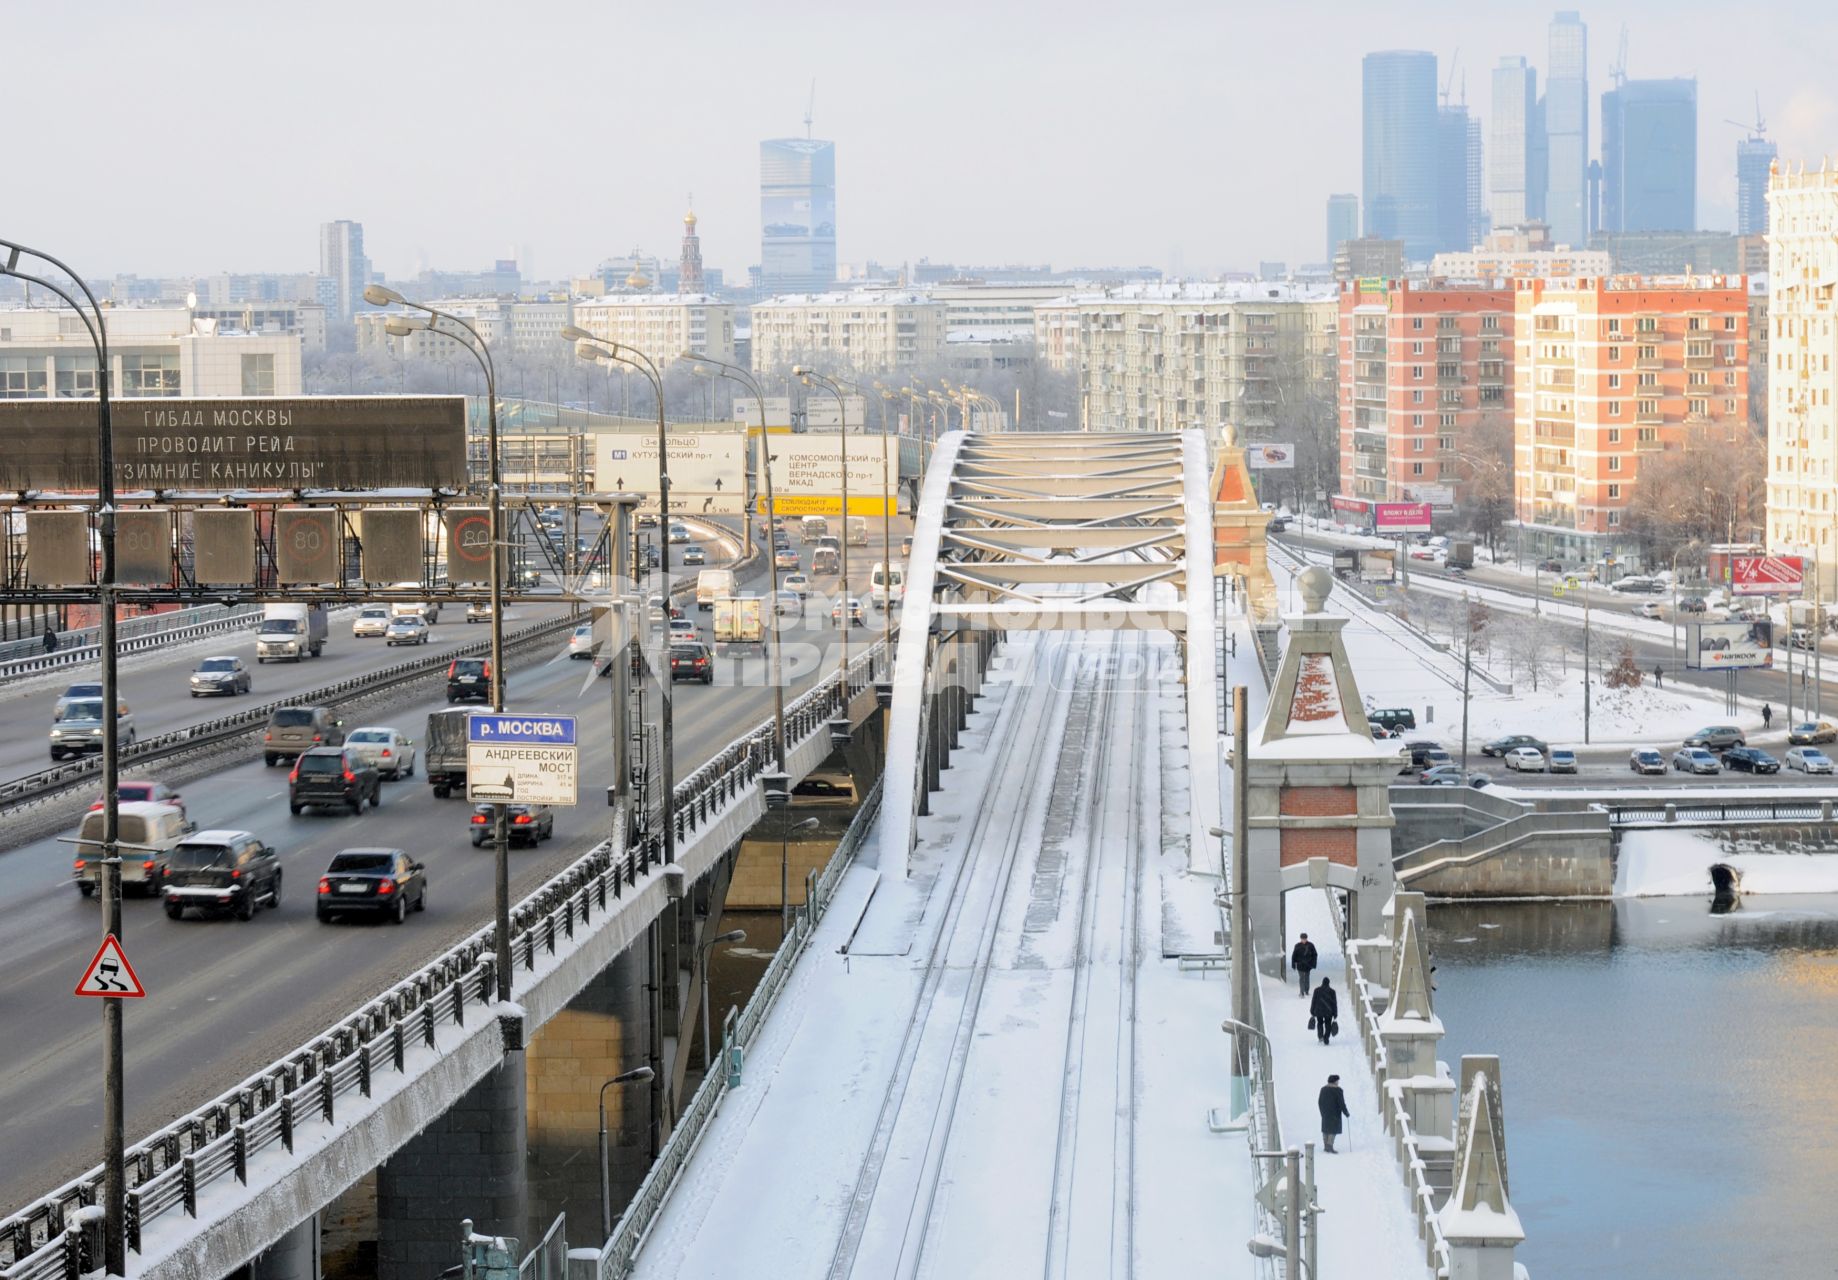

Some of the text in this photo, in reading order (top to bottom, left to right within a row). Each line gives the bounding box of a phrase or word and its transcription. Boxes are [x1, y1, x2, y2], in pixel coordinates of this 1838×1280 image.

[144, 409, 293, 427] ГИБДД МОСКВЫ
[137, 435, 295, 453] ПРОВОДИТ РЕЙД
[662, 437, 696, 447] ОЛЬЦО
[632, 449, 694, 459] КУТУЗВСКИЙ
[211, 462, 325, 480] КАНИКУЛЫ"
[788, 462, 818, 470] ЦЕНТР
[788, 471, 854, 479] ВЕРНАДСКОО
[127, 531, 153, 551] 80
[295, 530, 320, 550] 80
[463, 529, 489, 549] 80
[480, 720, 563, 736] р. МОСКВА
[485, 749, 573, 761] АНДРЕЕВСКИЙ
[538, 762, 572, 773] МОСТ
